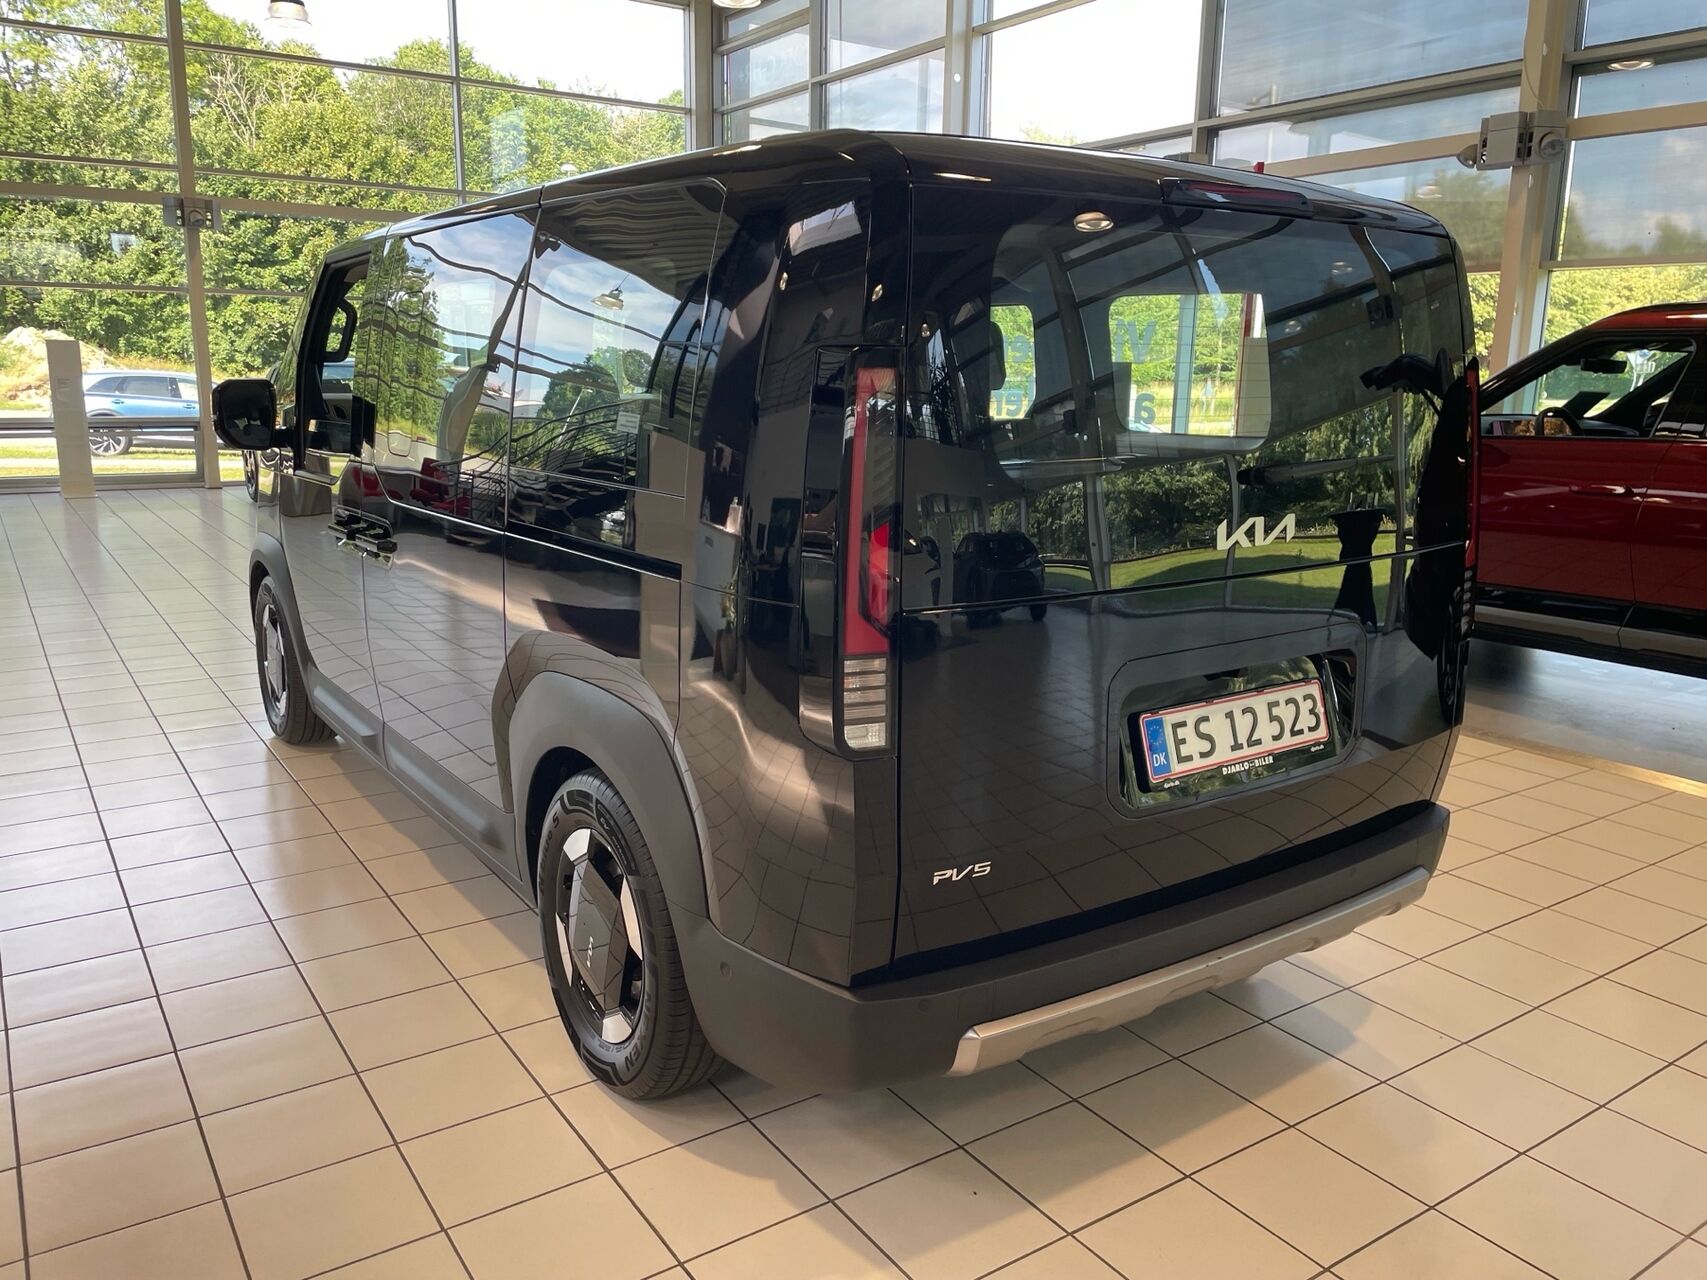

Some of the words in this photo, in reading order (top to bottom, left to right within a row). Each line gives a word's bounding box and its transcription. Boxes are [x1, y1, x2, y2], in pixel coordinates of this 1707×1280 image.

[1217, 513, 1296, 551] KIA
[1171, 716, 1217, 764] ES
[1224, 706, 1263, 752] 12
[1267, 693, 1322, 742] 523
[1153, 753, 1167, 767] DK
[933, 861, 991, 885] PV5
